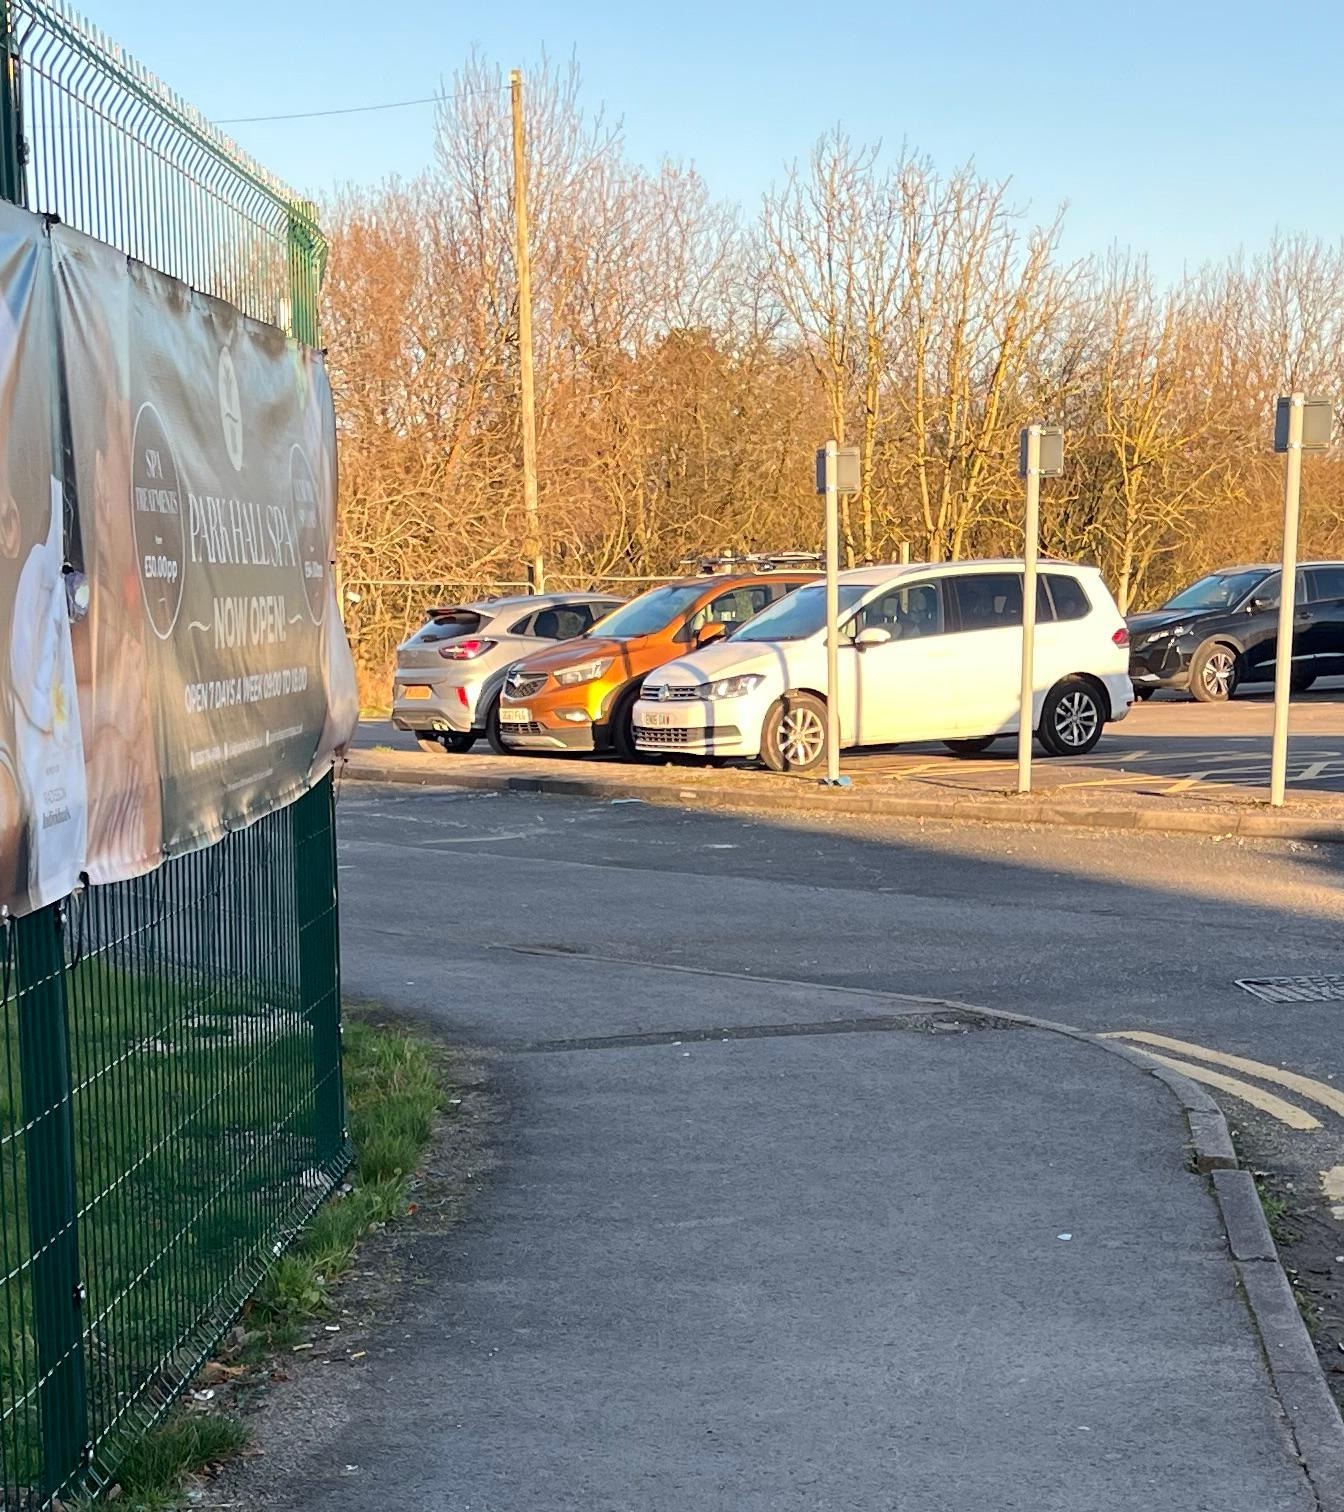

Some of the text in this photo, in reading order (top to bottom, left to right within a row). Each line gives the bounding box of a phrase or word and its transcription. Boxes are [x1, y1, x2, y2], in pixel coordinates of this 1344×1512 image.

[187, 492, 297, 568] PARK HALL SPA
[213, 594, 287, 650] NOW OPEN!
[184, 683, 208, 713] OPEN
[208, 681, 215, 710] 7
[215, 678, 236, 709] DAYS
[236, 677, 242, 705] A
[243, 673, 263, 704] WEEK
